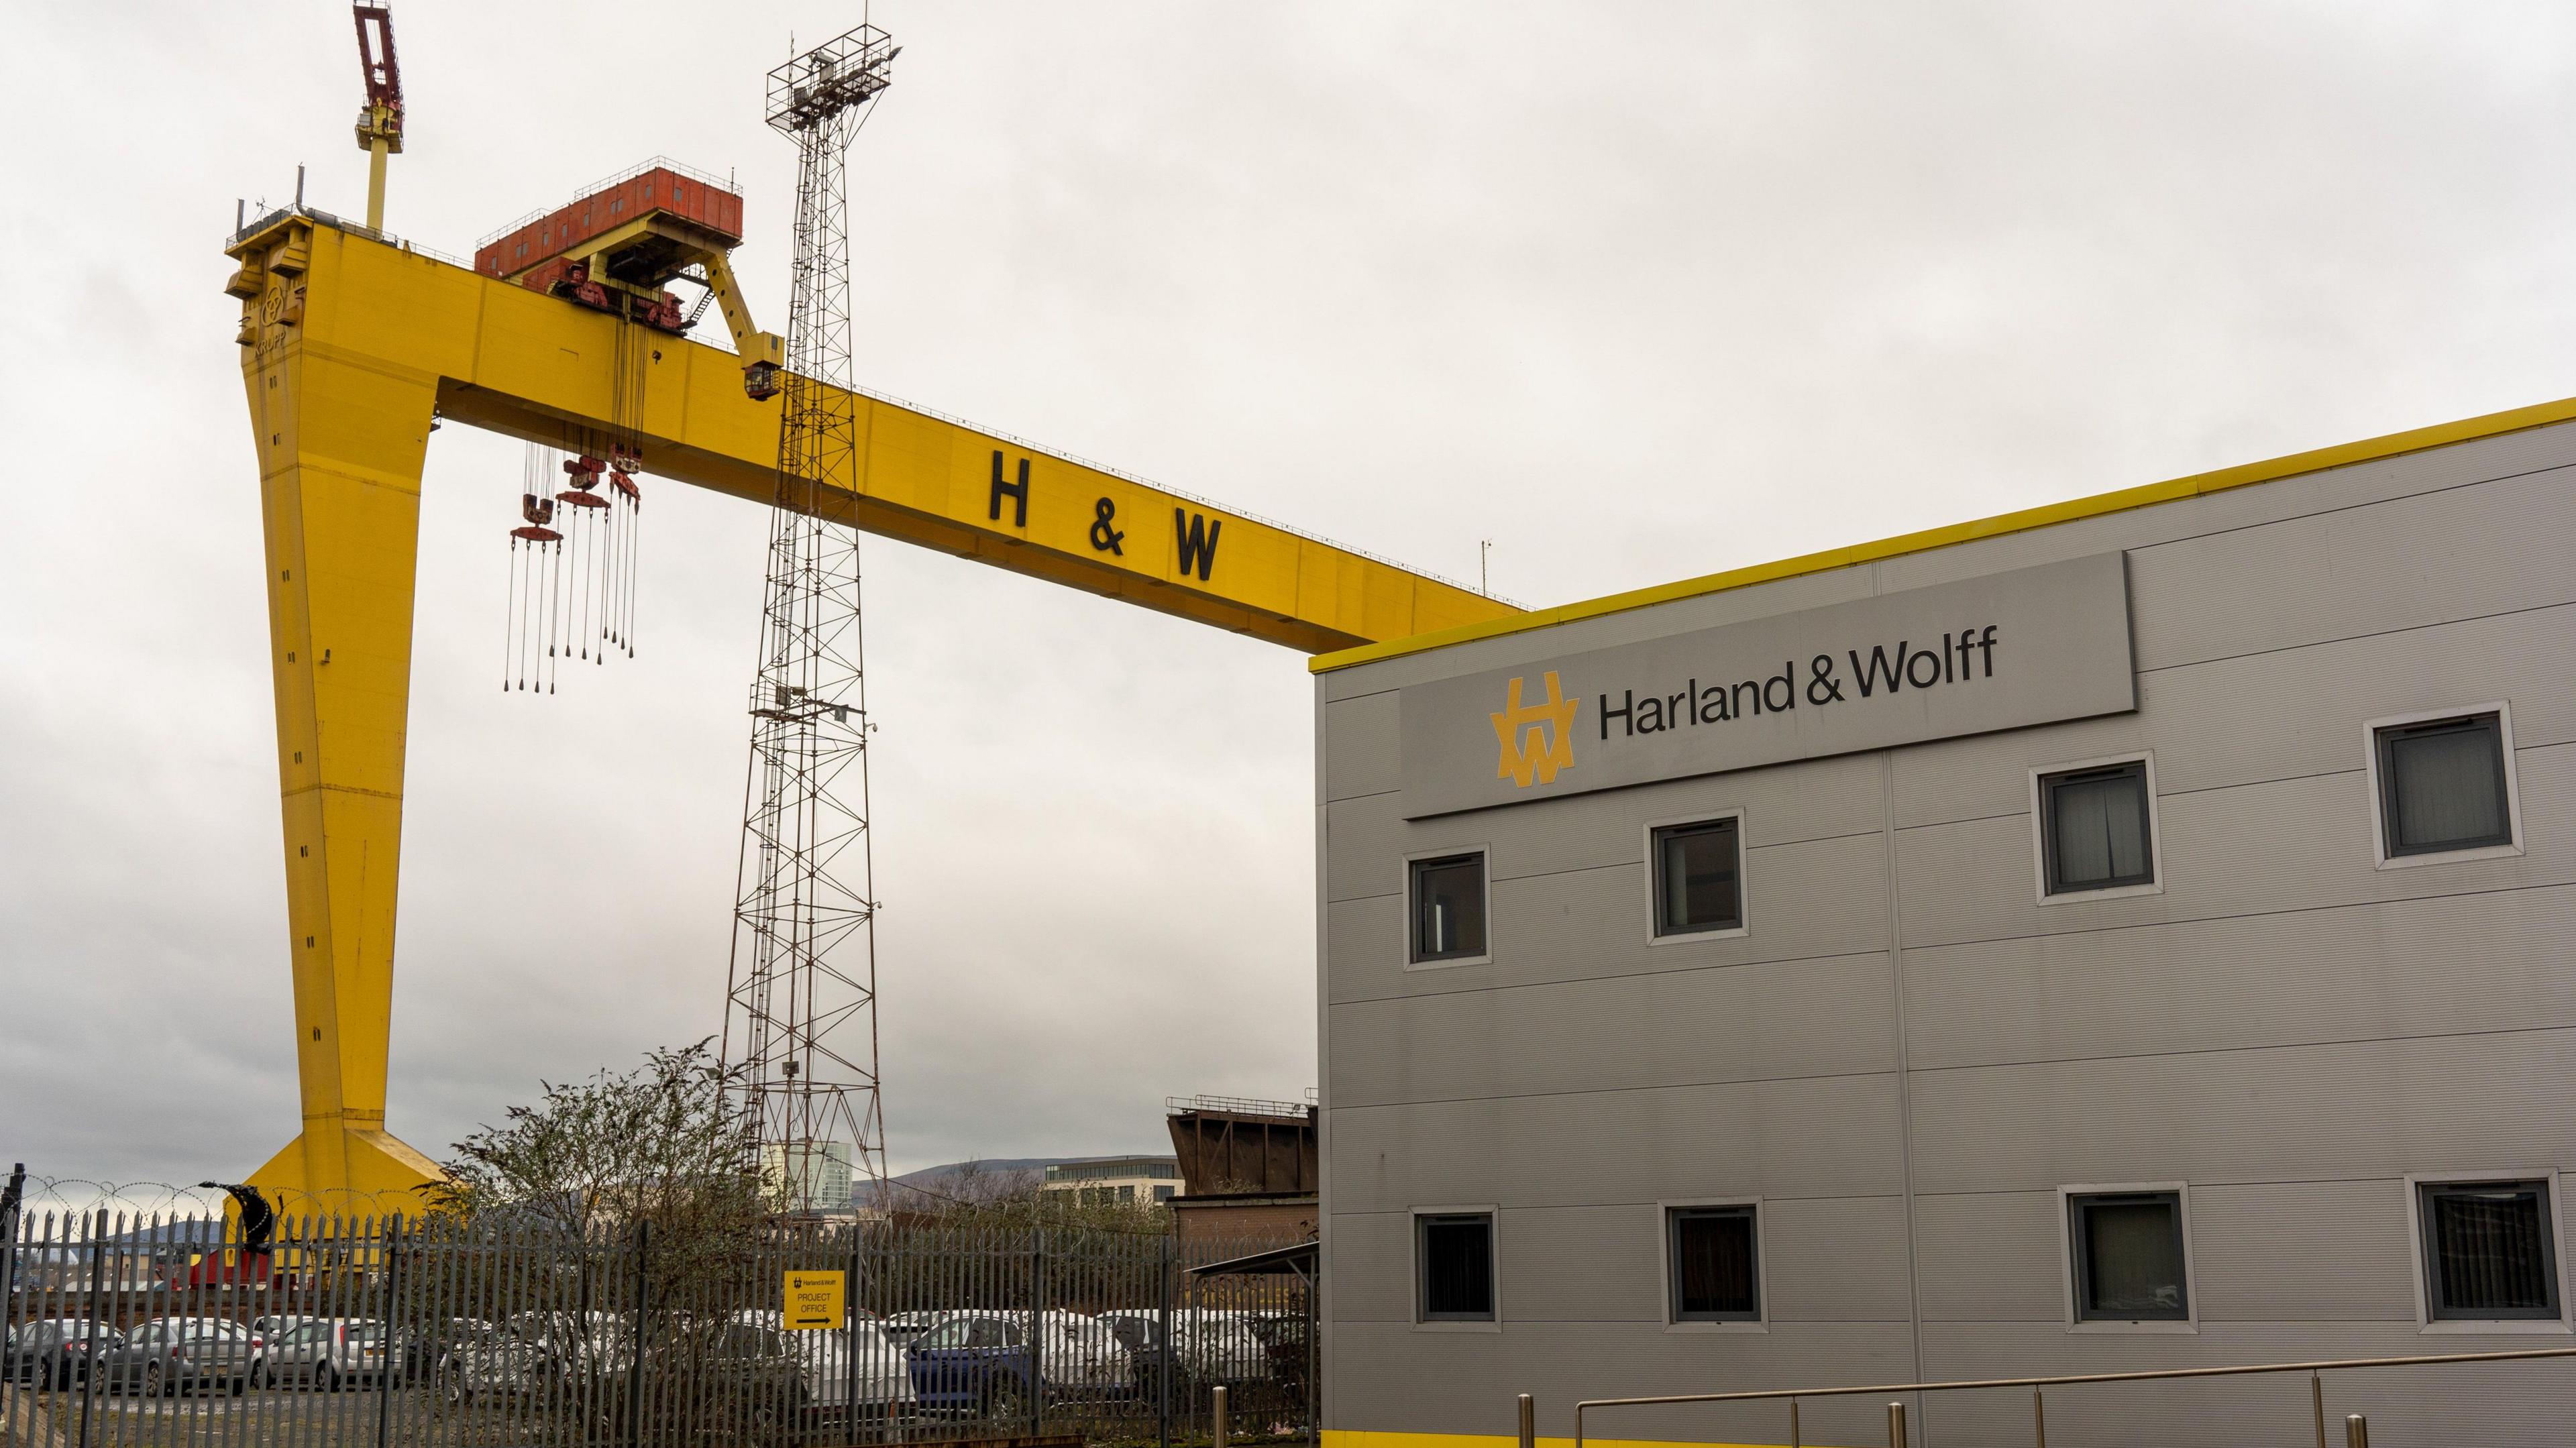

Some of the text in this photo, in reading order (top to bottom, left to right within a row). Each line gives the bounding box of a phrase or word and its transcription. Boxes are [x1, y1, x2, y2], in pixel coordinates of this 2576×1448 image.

[256, 330, 286, 355] KRUPP
[989, 450, 1222, 581] H & W
[1599, 624, 1998, 740] Harland & Wolff
[798, 1293, 830, 1301] PROJECT
[801, 1304, 827, 1313] OFFICE
